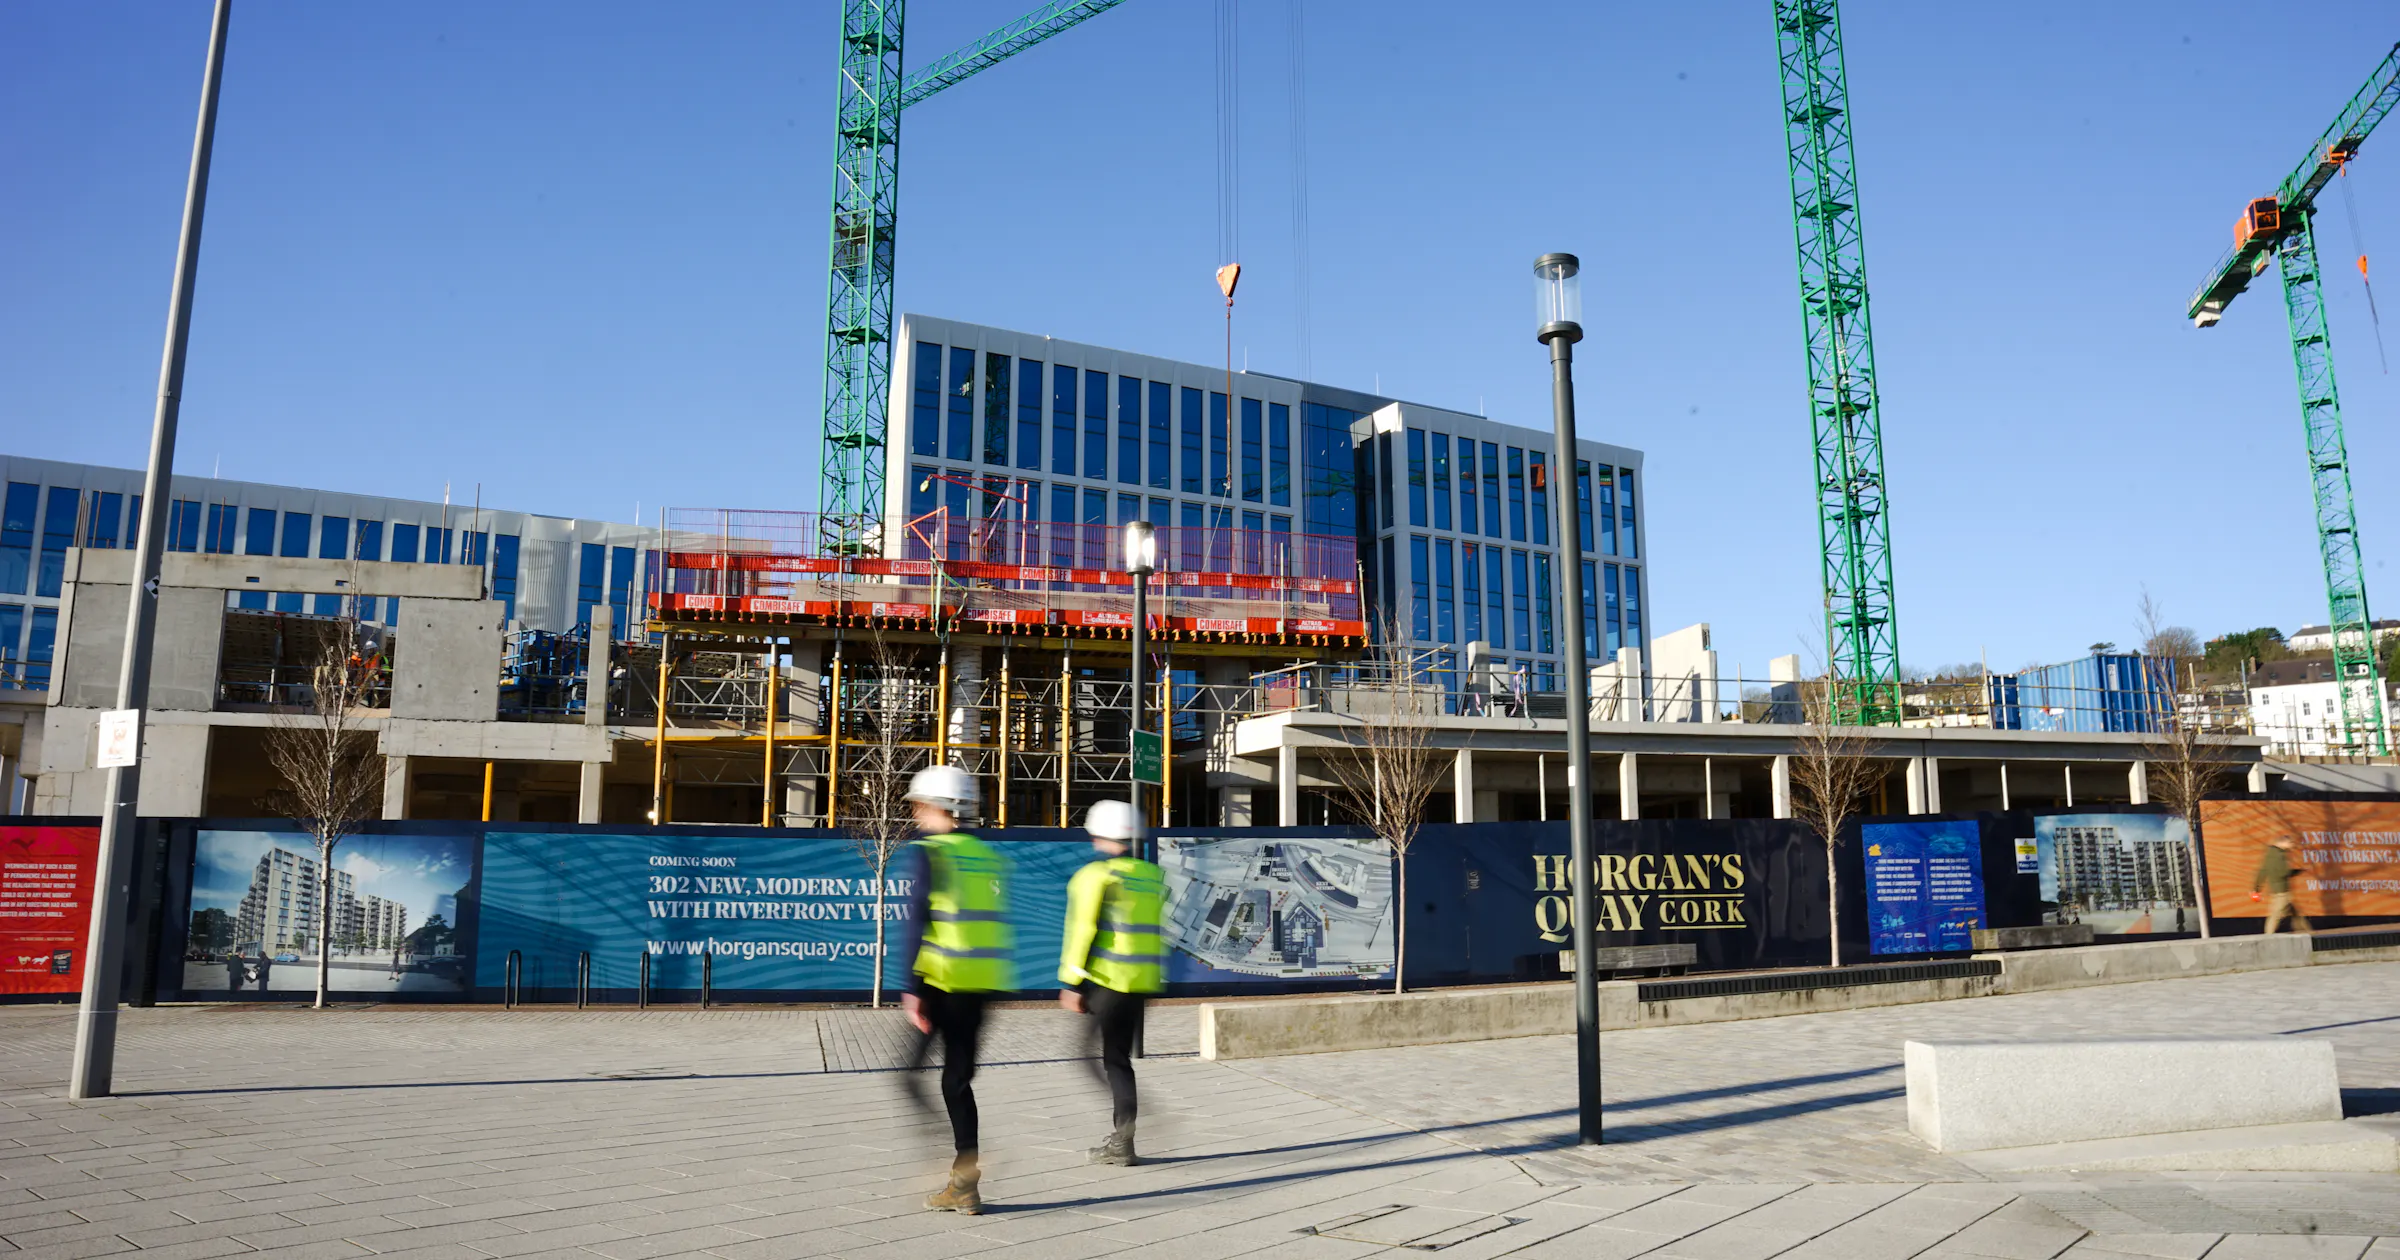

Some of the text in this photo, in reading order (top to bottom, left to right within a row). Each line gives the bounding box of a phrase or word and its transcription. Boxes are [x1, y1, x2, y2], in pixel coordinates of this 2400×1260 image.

[1022, 567, 1068, 581] COMBSAFE
[753, 599, 802, 613] COMBISAFE
[966, 608, 1012, 621] COMBISAFE
[1199, 618, 1243, 631] COMBISAFE
[2343, 831, 2400, 848] QUAYSID
[649, 855, 737, 867] COMING SOON
[2302, 849, 2329, 863] FOR
[2330, 849, 2393, 863] WORKING
[649, 875, 690, 894] 302
[694, 876, 751, 897] NEW,
[755, 877, 852, 895] MODERN
[648, 900, 710, 919] WITH
[714, 901, 855, 920] RIVERFRONT
[1659, 900, 1745, 924] CORK
